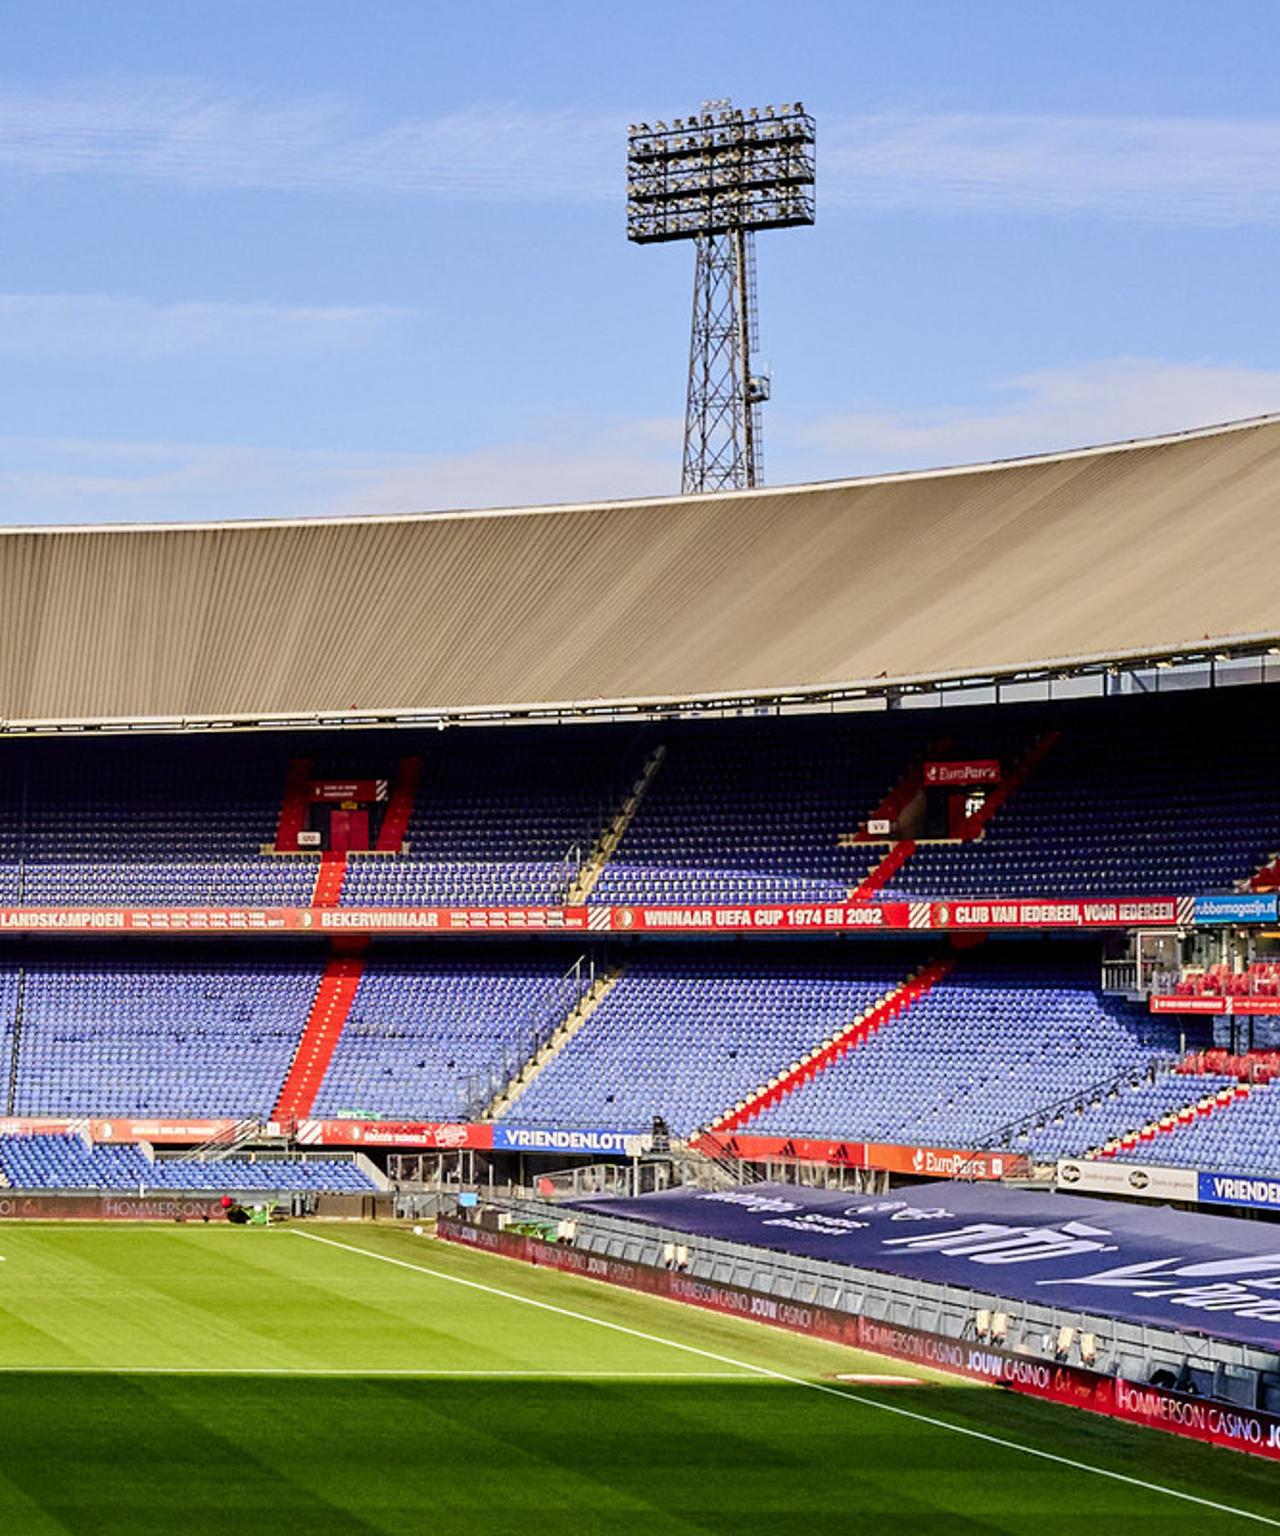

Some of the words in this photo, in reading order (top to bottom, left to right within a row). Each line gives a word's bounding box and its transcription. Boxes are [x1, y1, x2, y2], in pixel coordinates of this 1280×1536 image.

[1, 912, 124, 926] LANDSKAMPIOEN
[321, 912, 438, 927] BEKERWINNAAR
[644, 909, 712, 926] WINNAAR
[716, 909, 751, 925] UEFA
[754, 909, 783, 925] CUP
[787, 909, 822, 925] 1974
[825, 908, 843, 925] EN
[847, 908, 882, 924] 2002
[955, 907, 988, 923] CLUB
[992, 906, 1017, 923] VAN
[1020, 903, 1082, 925] IEDEREEN,
[1084, 903, 1116, 922] VOOR
[1119, 902, 1174, 921] IEDEREEN
[925, 1151, 987, 1175] EuroParcs
[105, 1200, 212, 1217] HOMMERSON
[751, 1296, 777, 1319] JOUW
[860, 1321, 924, 1356] HOMMERSON
[967, 1351, 1002, 1377] JOUW
[1004, 1360, 1050, 1390] CASINO!
[1118, 1383, 1205, 1429] HOMMERSON
